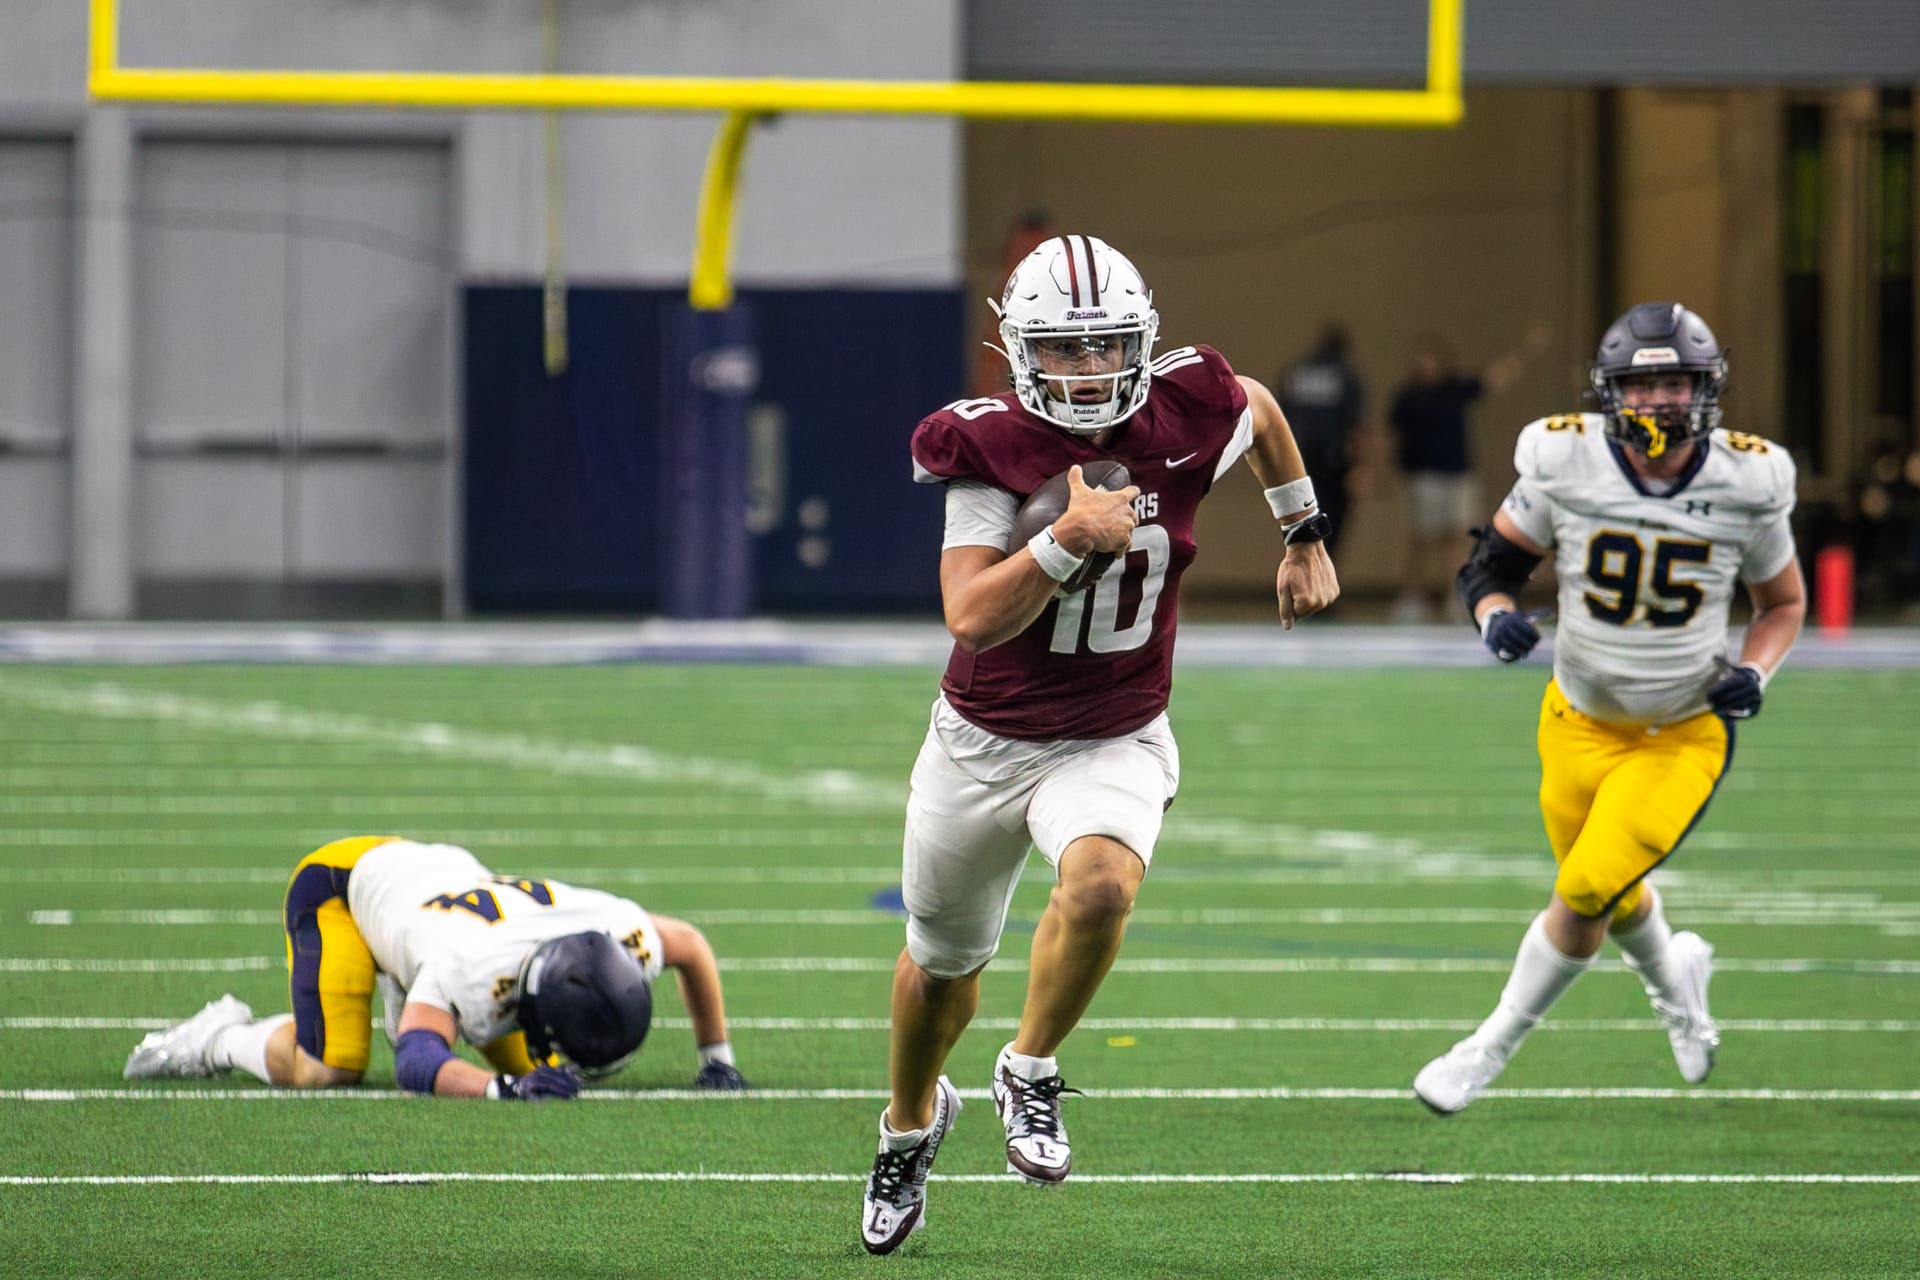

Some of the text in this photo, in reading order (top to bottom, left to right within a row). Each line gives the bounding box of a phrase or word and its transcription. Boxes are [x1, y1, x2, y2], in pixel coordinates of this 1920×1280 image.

[1072, 407, 1100, 416] Riddell
[1050, 523, 1170, 655] 10
[1584, 528, 1713, 627] 95
